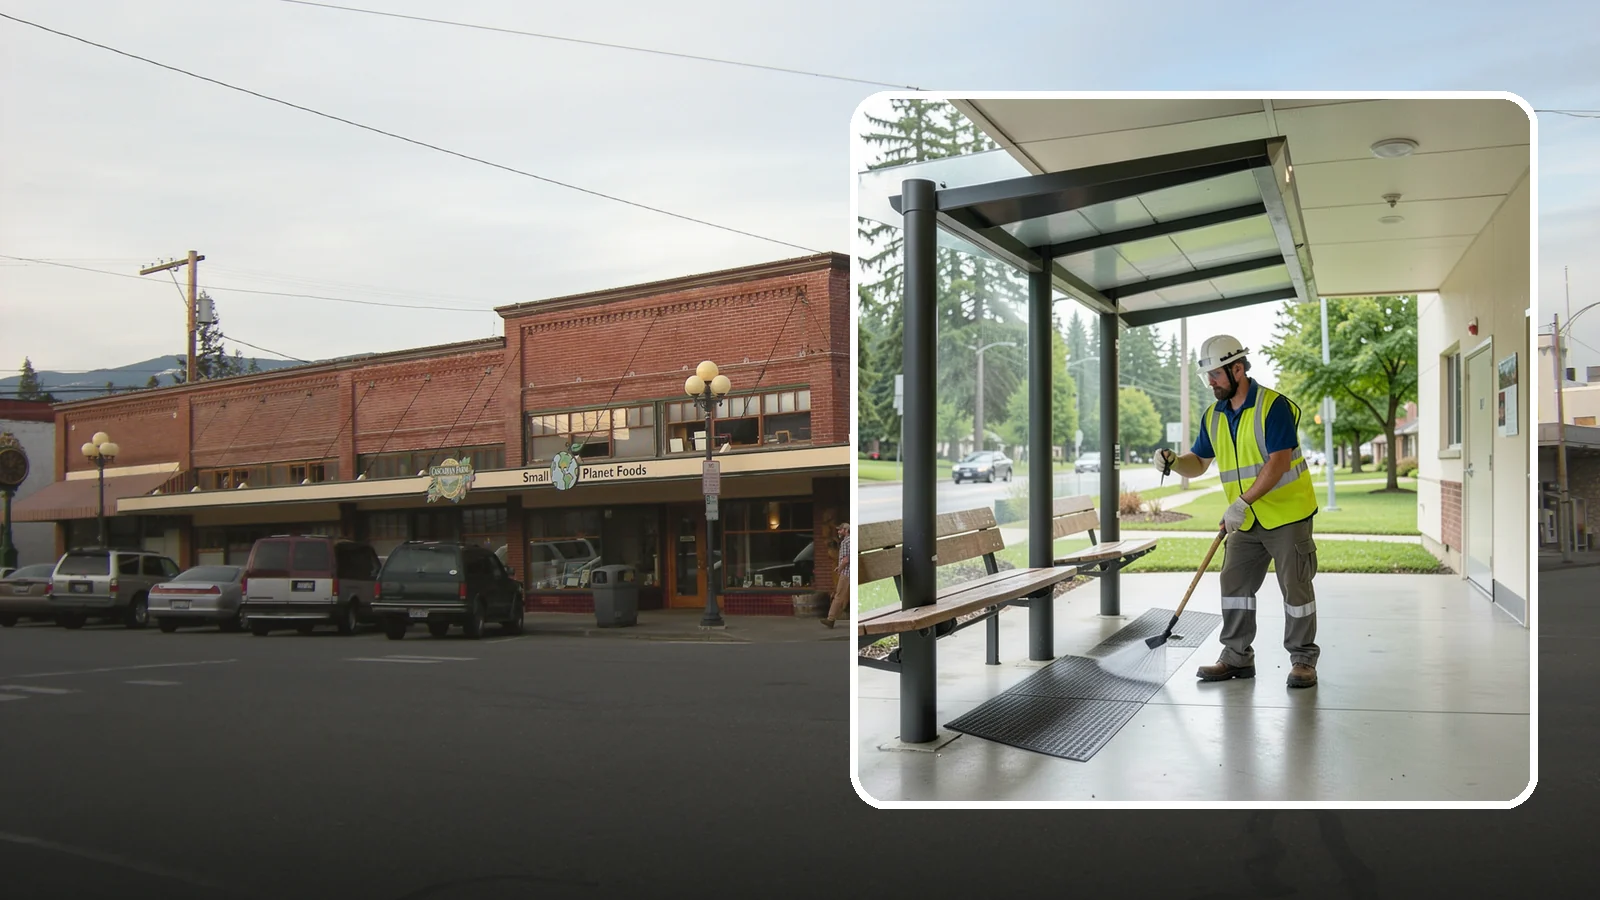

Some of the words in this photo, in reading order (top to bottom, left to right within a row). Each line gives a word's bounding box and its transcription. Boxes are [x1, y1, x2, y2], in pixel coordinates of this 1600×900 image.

[523, 471, 549, 483] Small
[583, 467, 614, 479] Planet
[617, 464, 647, 477] Foods
